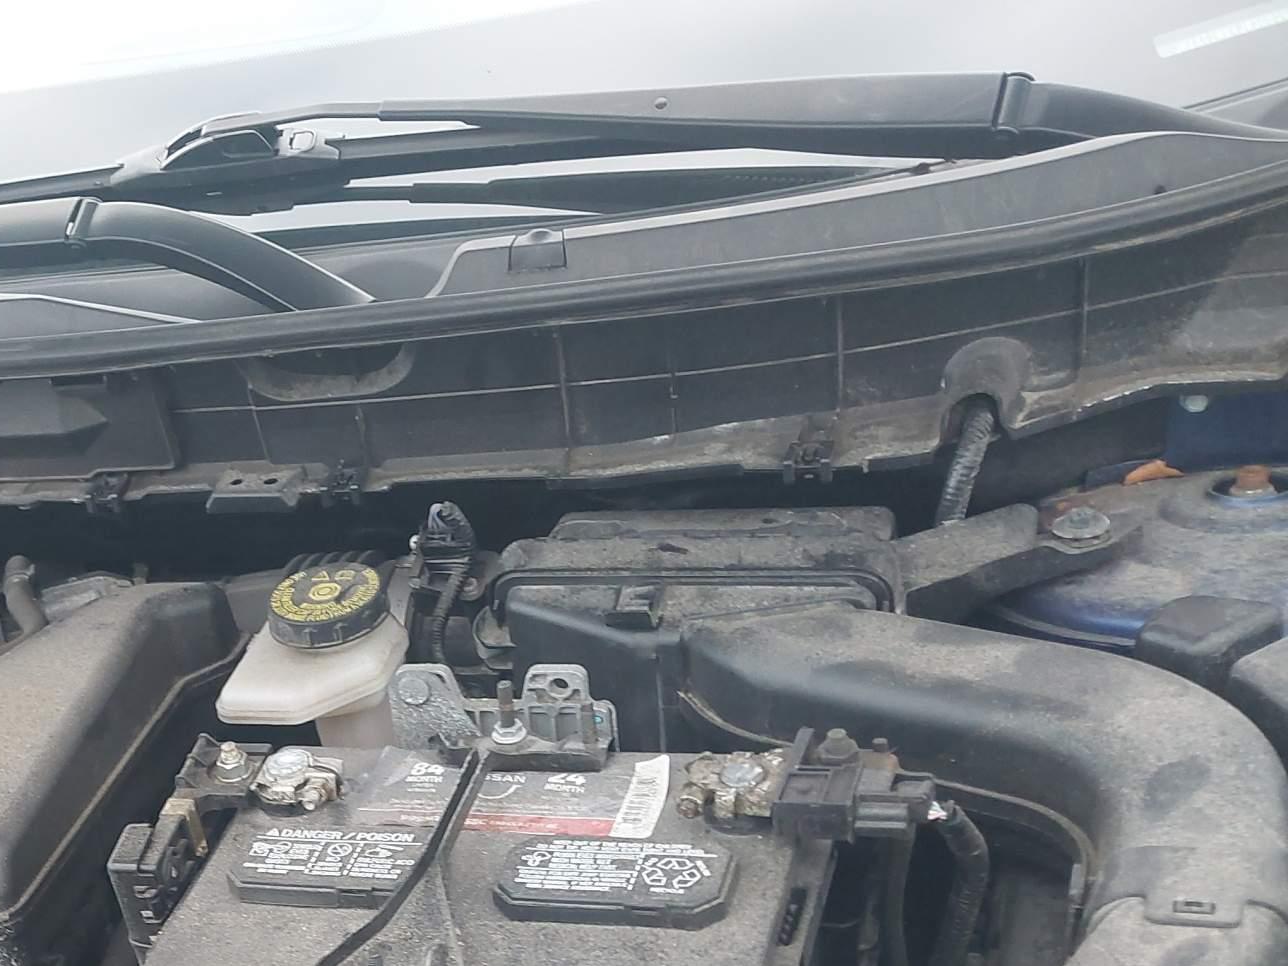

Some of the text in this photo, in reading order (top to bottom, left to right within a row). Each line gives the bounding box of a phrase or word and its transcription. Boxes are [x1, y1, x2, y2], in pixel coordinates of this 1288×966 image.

[412, 763, 445, 776] 84
[405, 775, 443, 783] MONTH
[544, 783, 585, 794] MONTH
[281, 828, 343, 840] DANGER
[356, 832, 415, 843] POISON
